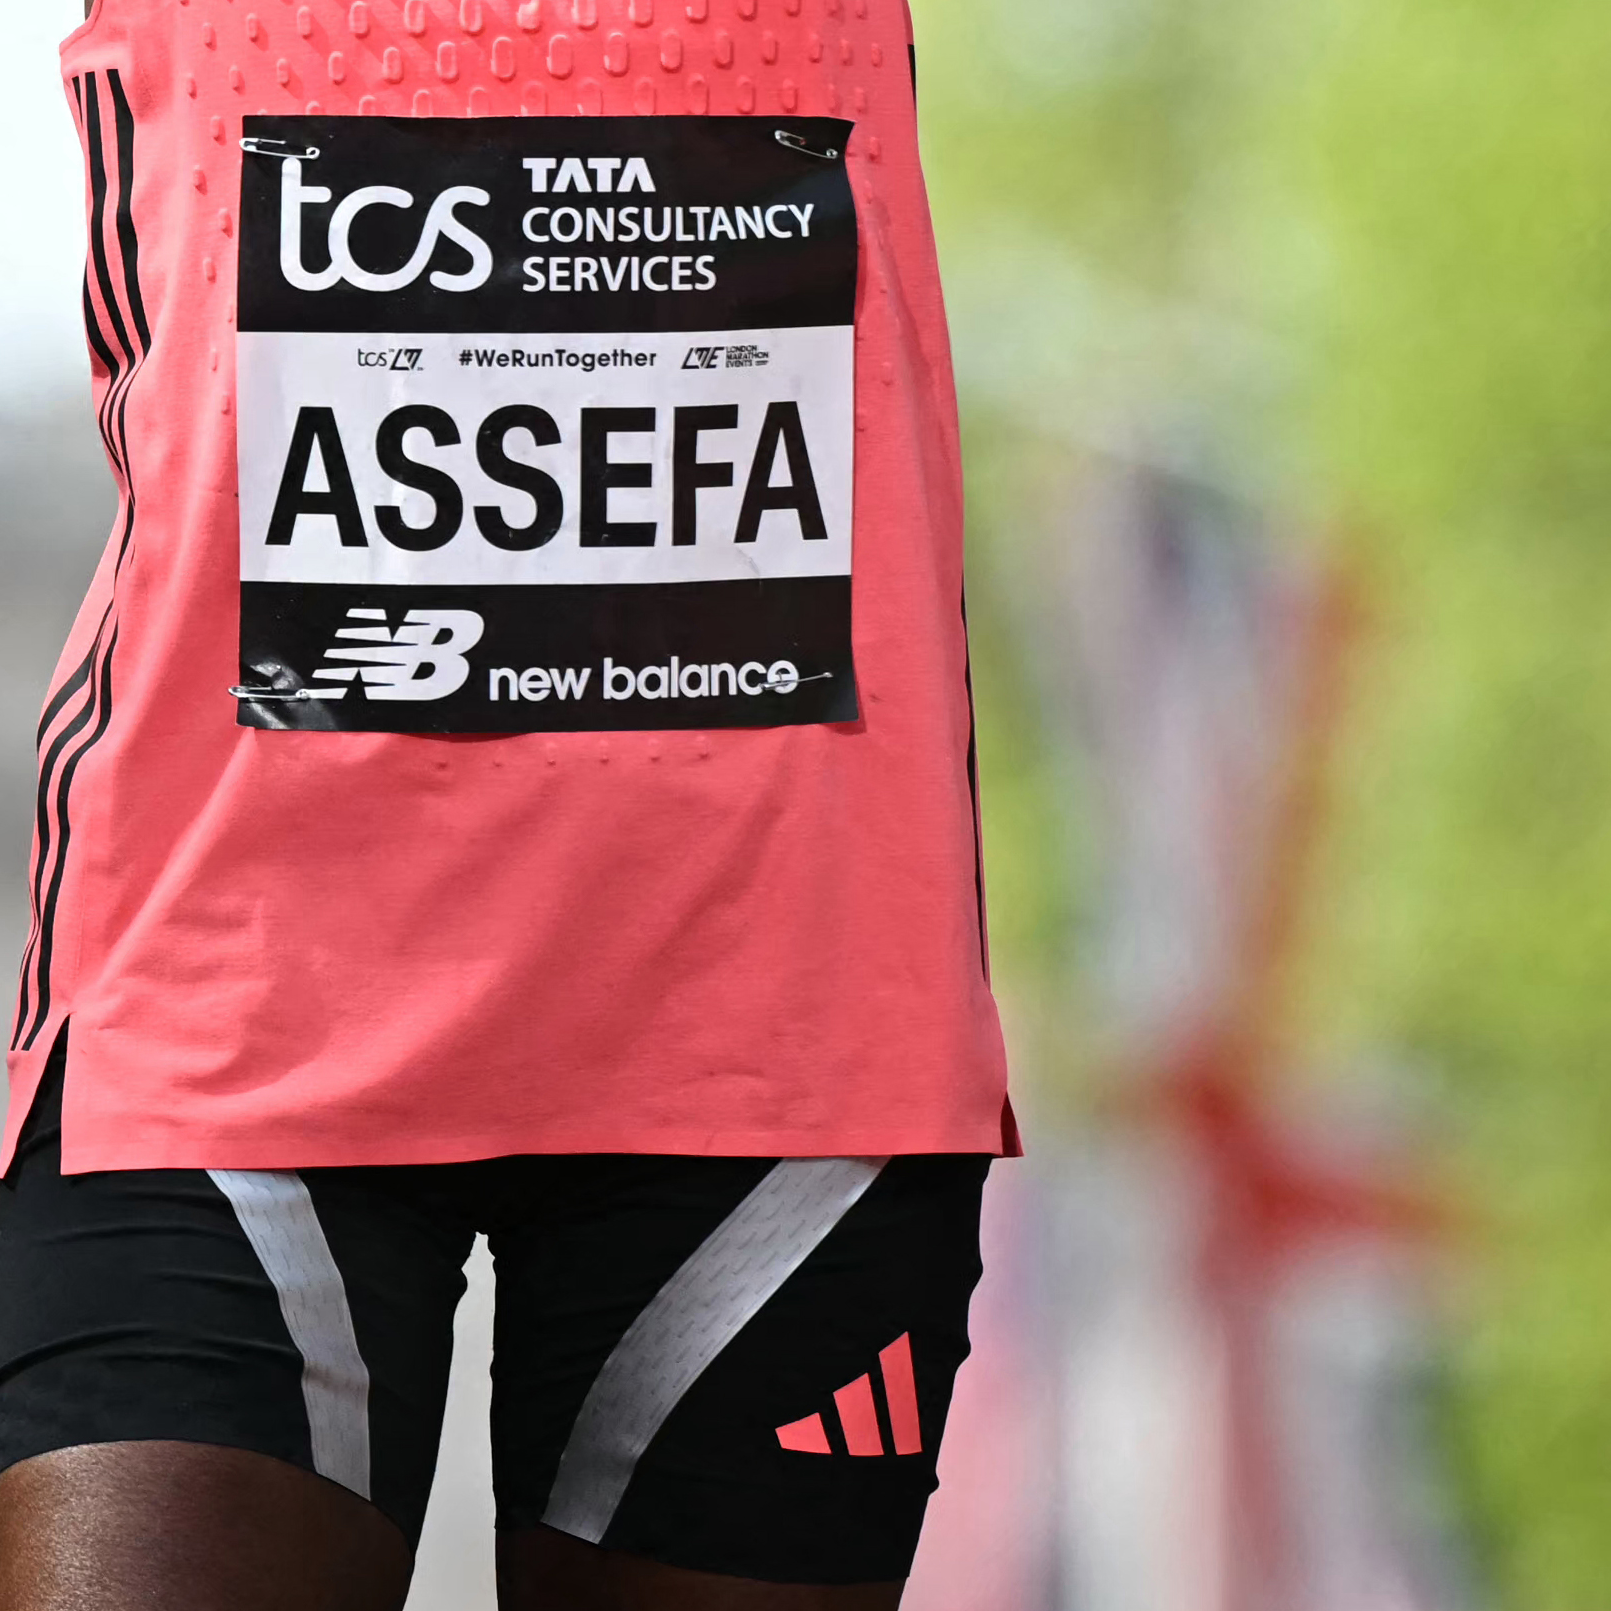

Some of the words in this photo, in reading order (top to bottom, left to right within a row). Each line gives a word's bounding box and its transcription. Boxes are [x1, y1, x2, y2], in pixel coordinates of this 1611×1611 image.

[522, 157, 656, 193] TATA
[279, 156, 493, 292] tcs
[522, 203, 815, 243] CONSULTANCY
[522, 254, 717, 293] SERVICES
[458, 348, 657, 373] #WeRunTogether
[264, 400, 829, 552] ASSEFA
[309, 608, 485, 701] NB
[489, 667, 592, 702] new
[603, 655, 800, 701] balance
